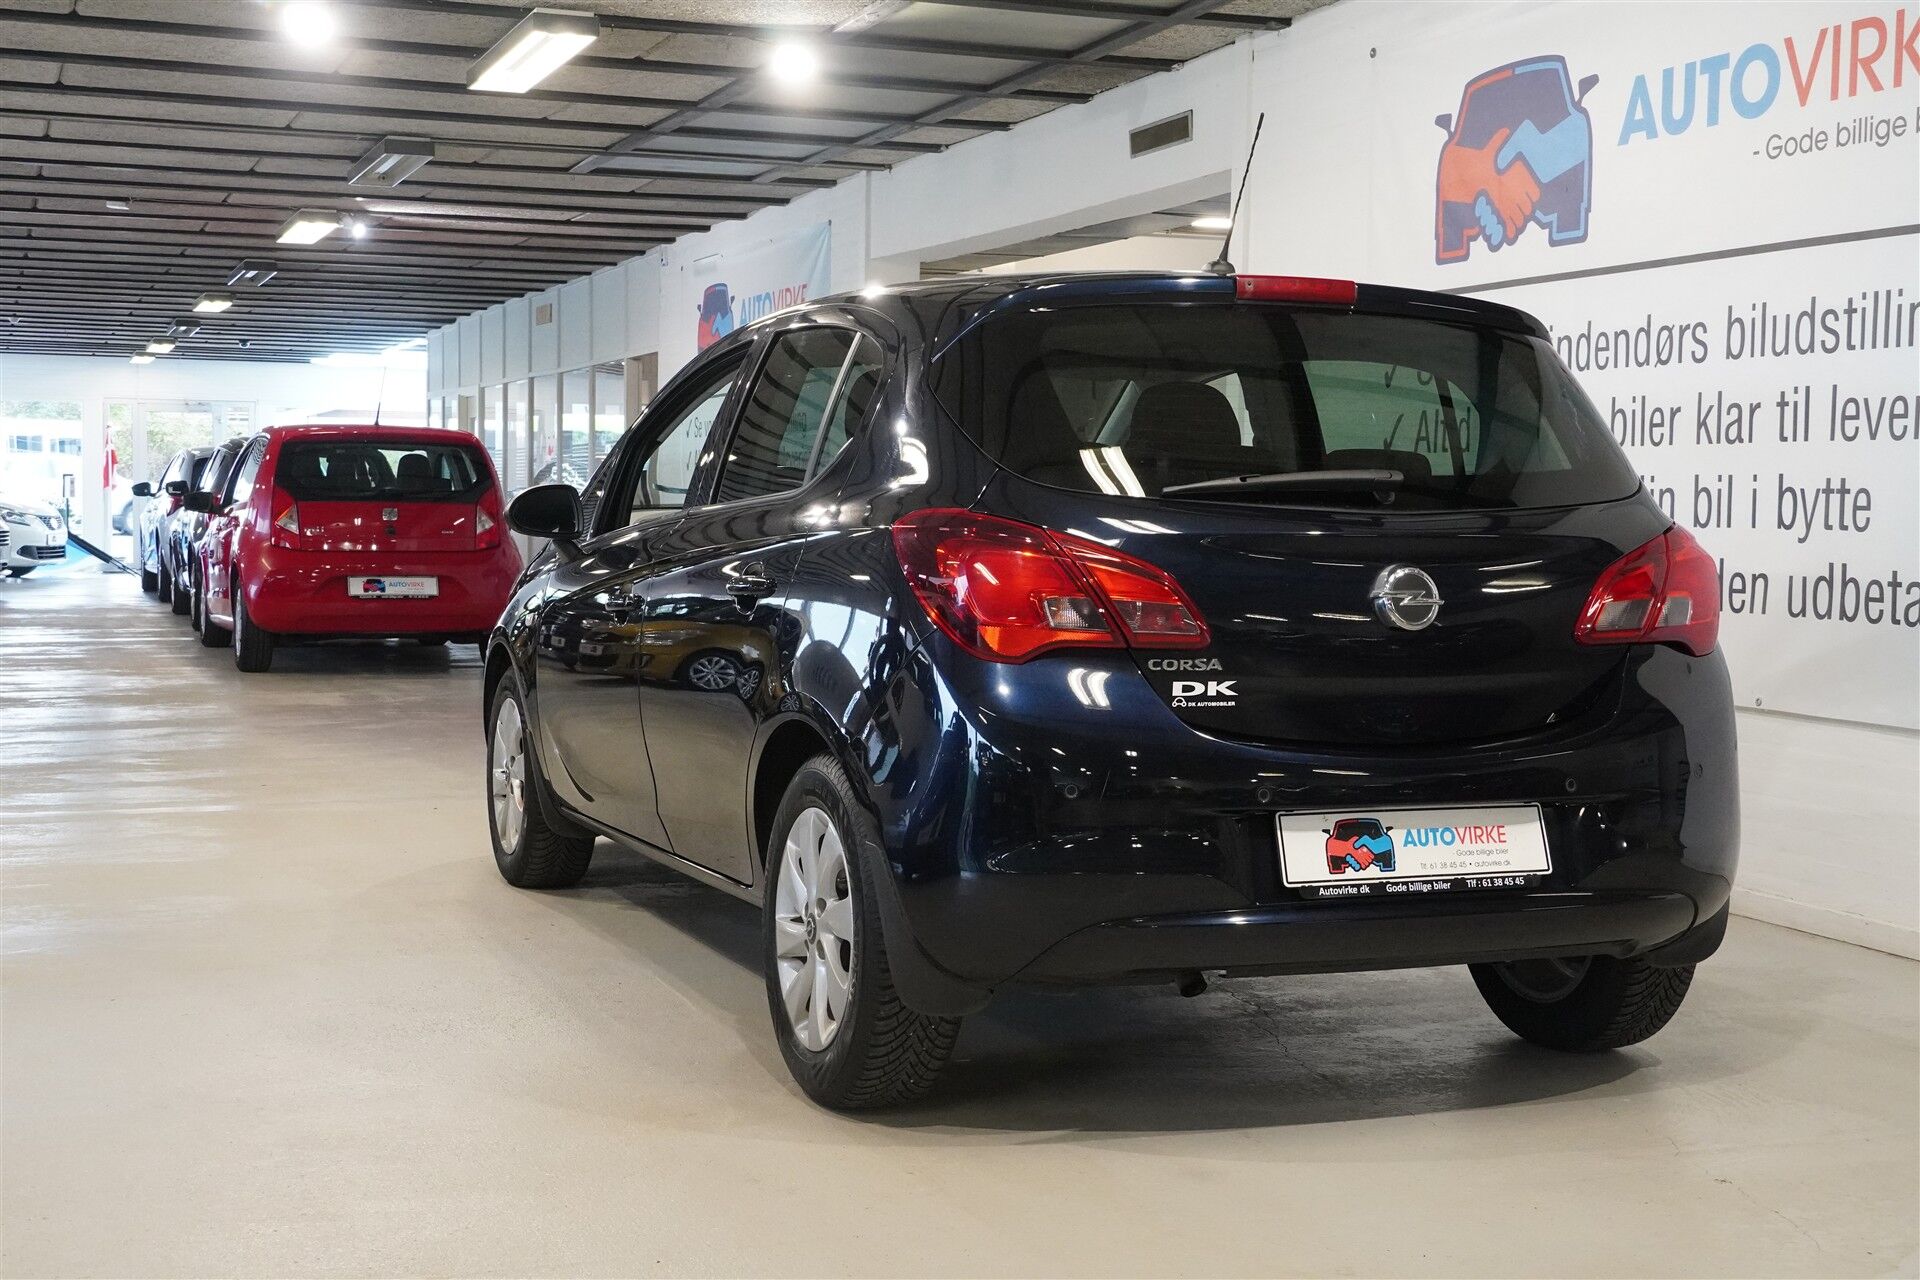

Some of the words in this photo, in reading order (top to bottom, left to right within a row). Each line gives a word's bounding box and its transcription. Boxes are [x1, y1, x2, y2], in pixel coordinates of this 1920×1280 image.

[1766, 127, 1829, 159] Gode
[1836, 115, 1908, 147] billige
[1550, 314, 1709, 372] ndendørs
[1611, 395, 1682, 447] biler
[1696, 389, 1761, 446] klar
[1776, 385, 1811, 443] til
[1692, 474, 1734, 530] bil
[1750, 474, 1758, 529] i
[1777, 473, 1872, 544] bytte
[1787, 562, 1920, 628] udbeta
[1148, 658, 1222, 671] CORSA
[1171, 680, 1239, 697] DK
[1403, 825, 1508, 848] AUTOVIRKE
[1456, 848, 1475, 857] Gode
[1385, 882, 1408, 893] Gode
[1408, 880, 1433, 892] billige
[1433, 880, 1451, 890] biler
[1482, 878, 1492, 887] 61
[1493, 877, 1503, 886] 38
[1504, 877, 1514, 886] 45
[1514, 876, 1525, 885] 45
